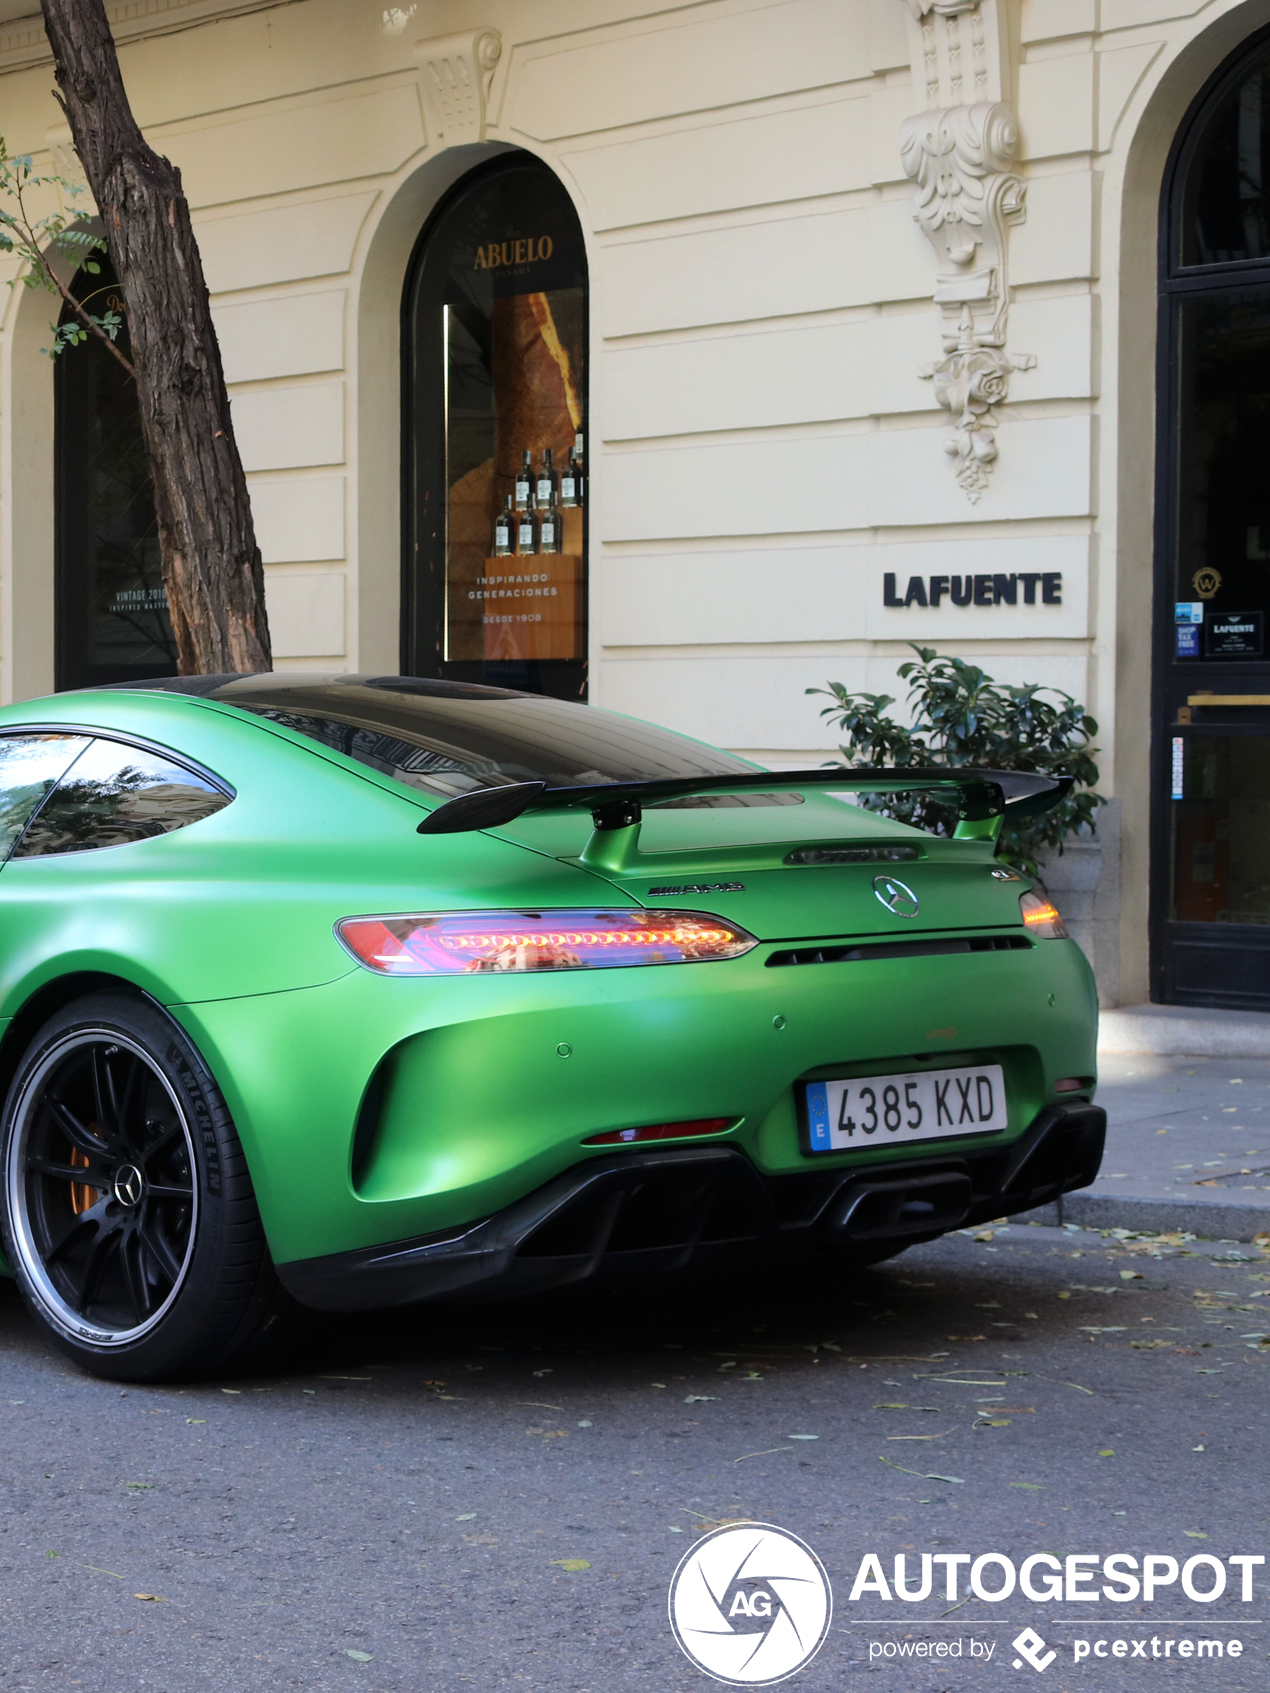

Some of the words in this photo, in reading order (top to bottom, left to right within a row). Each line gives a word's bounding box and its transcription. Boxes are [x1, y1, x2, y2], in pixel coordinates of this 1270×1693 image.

[474, 235, 553, 270] ABUELO
[476, 573, 548, 585] INSPIRANDO
[116, 590, 145, 602] VINTAGE
[468, 587, 558, 599] GENERACIONES
[883, 572, 1062, 607] LAFUENTE
[483, 615, 513, 624] DESDE
[517, 613, 542, 622] 1908
[1213, 624, 1255, 634] LAFUENTE
[837, 1082, 923, 1138] 4385
[934, 1075, 994, 1127] KXD
[181, 1069, 223, 1194] MICHELIN
[816, 1123, 825, 1138] E
